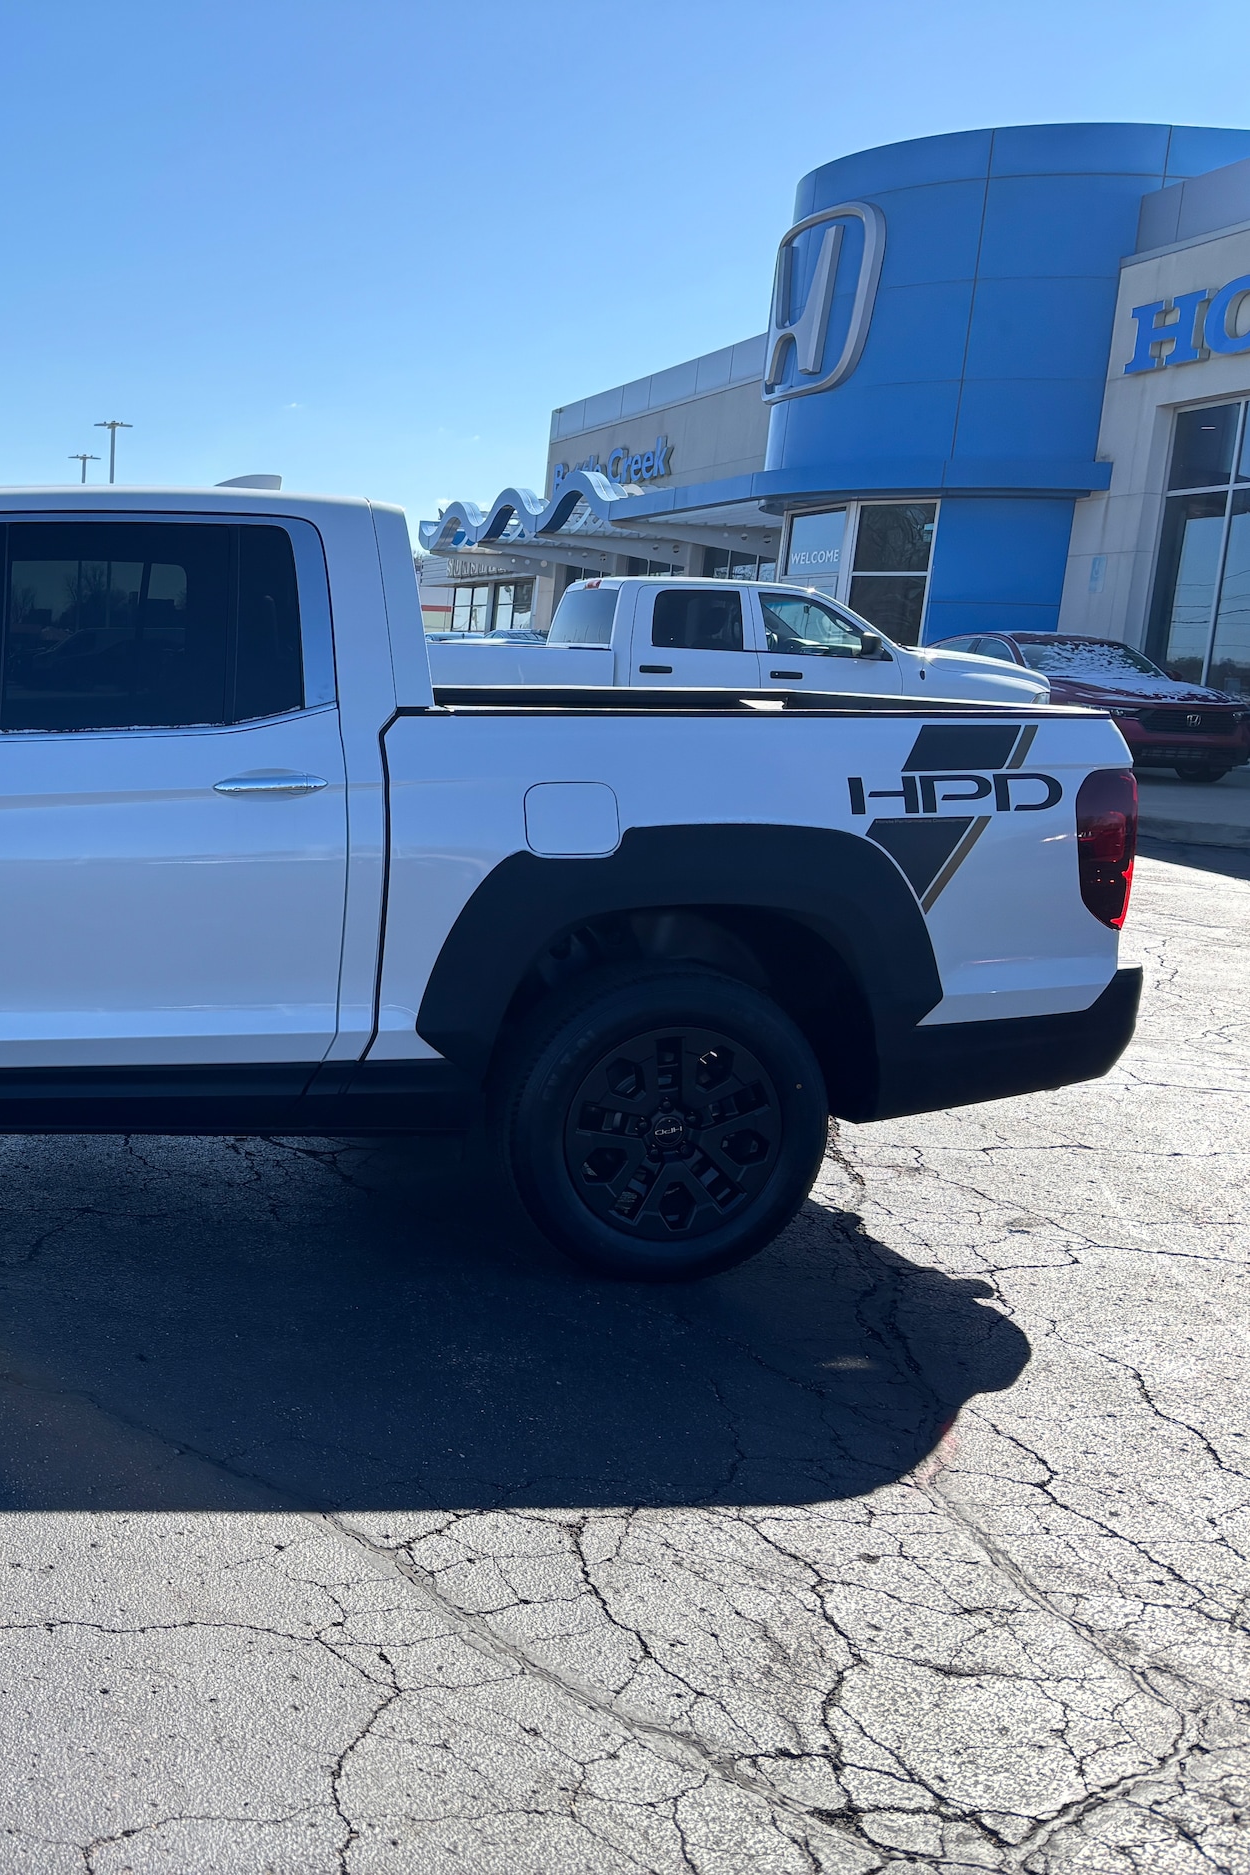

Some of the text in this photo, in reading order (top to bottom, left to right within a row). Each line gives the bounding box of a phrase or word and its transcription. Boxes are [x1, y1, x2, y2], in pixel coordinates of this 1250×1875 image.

[607, 435, 669, 484] Creek
[791, 549, 840, 565] WELCOME
[847, 773, 1063, 815] HPD
[654, 1125, 683, 1136] HPD
